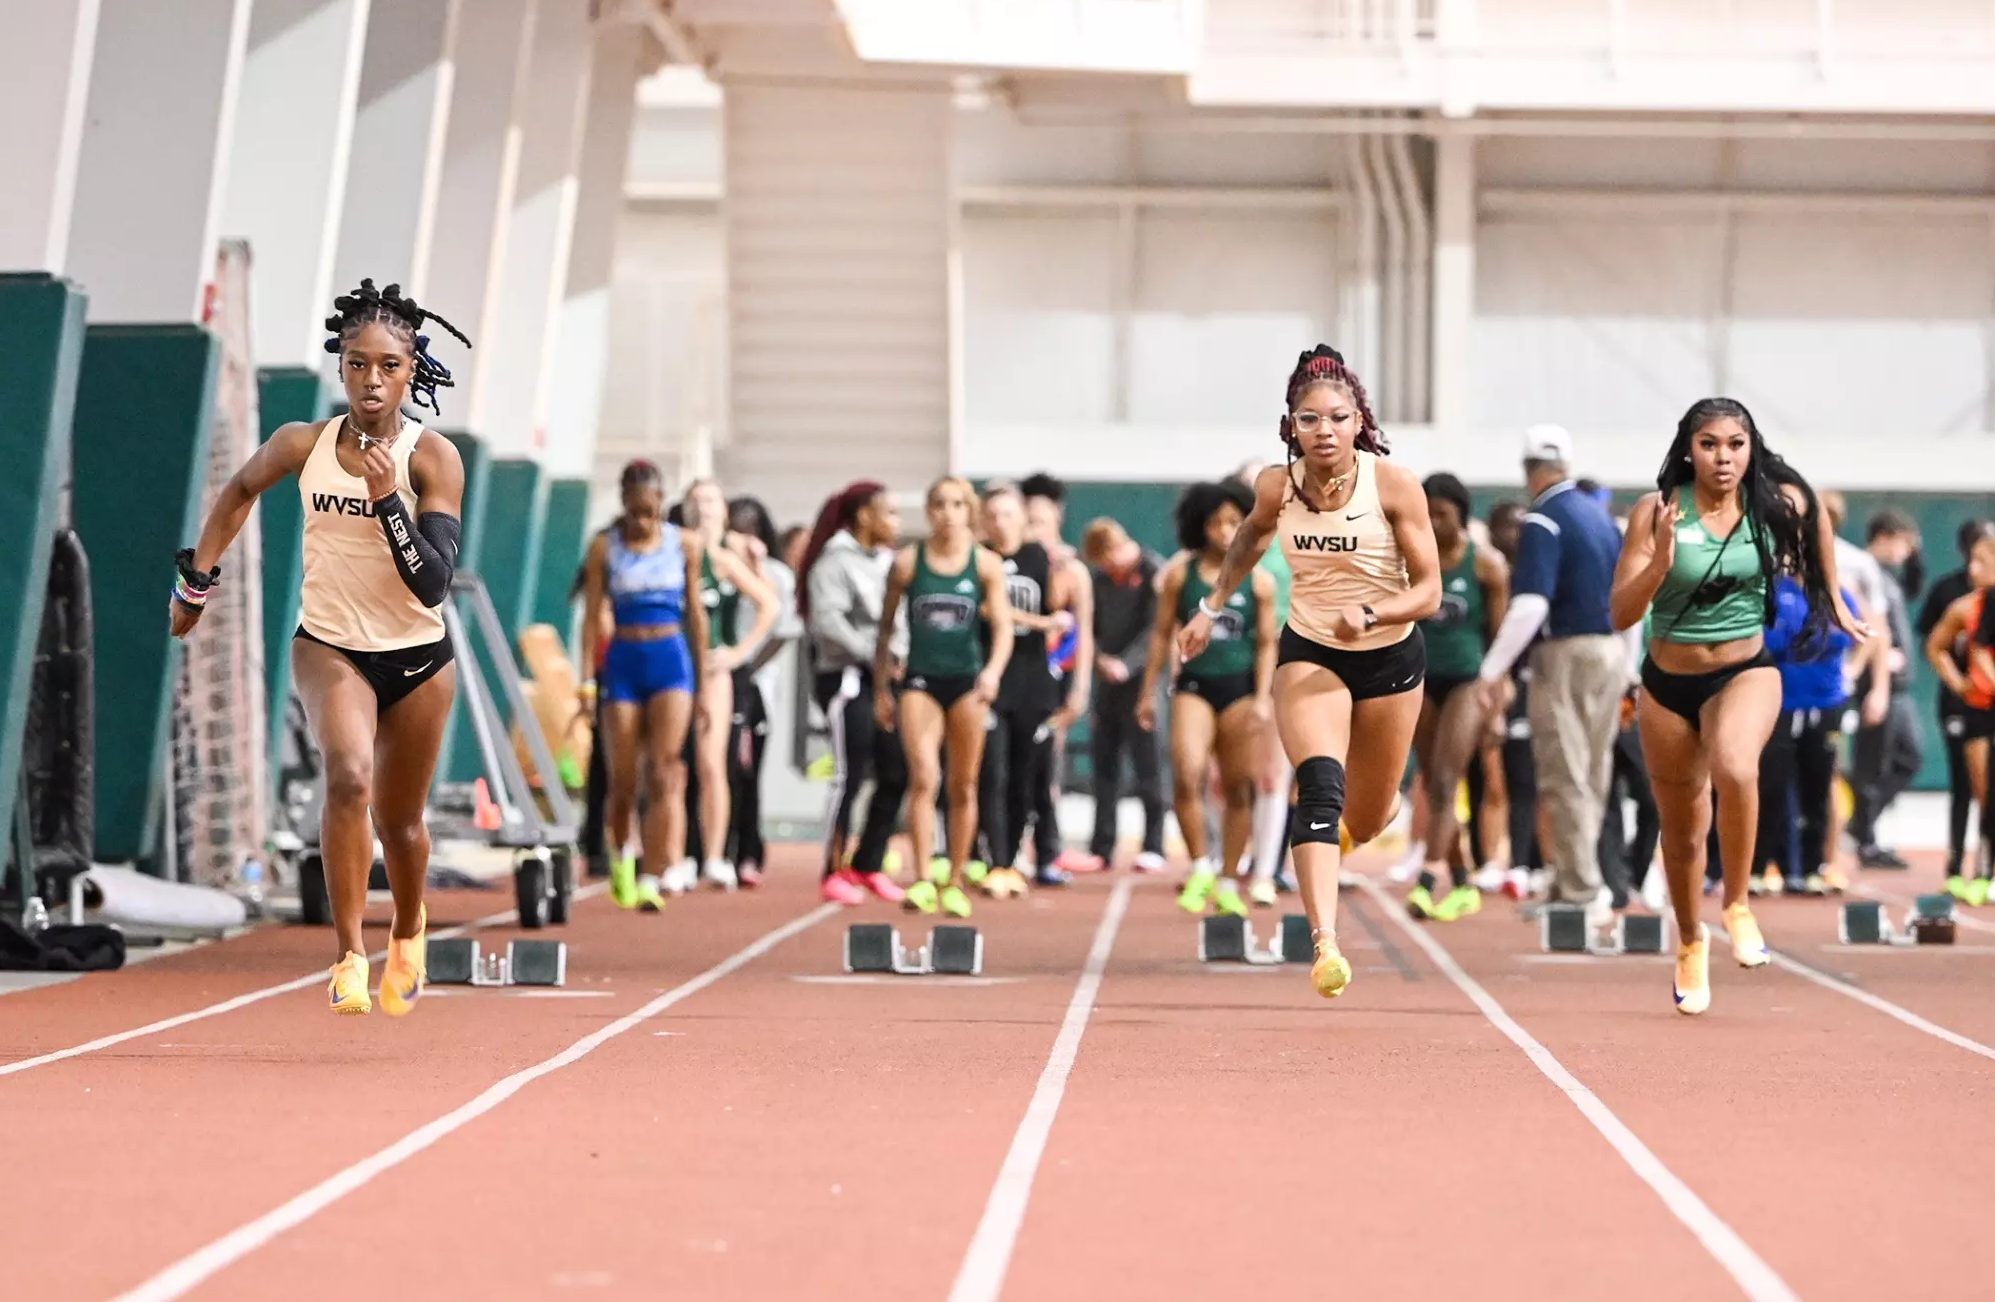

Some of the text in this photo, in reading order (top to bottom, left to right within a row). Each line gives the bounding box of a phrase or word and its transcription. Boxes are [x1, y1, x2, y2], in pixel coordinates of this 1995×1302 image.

[387, 513, 424, 574] THE NEST
[1293, 535, 1358, 552] WVSU
